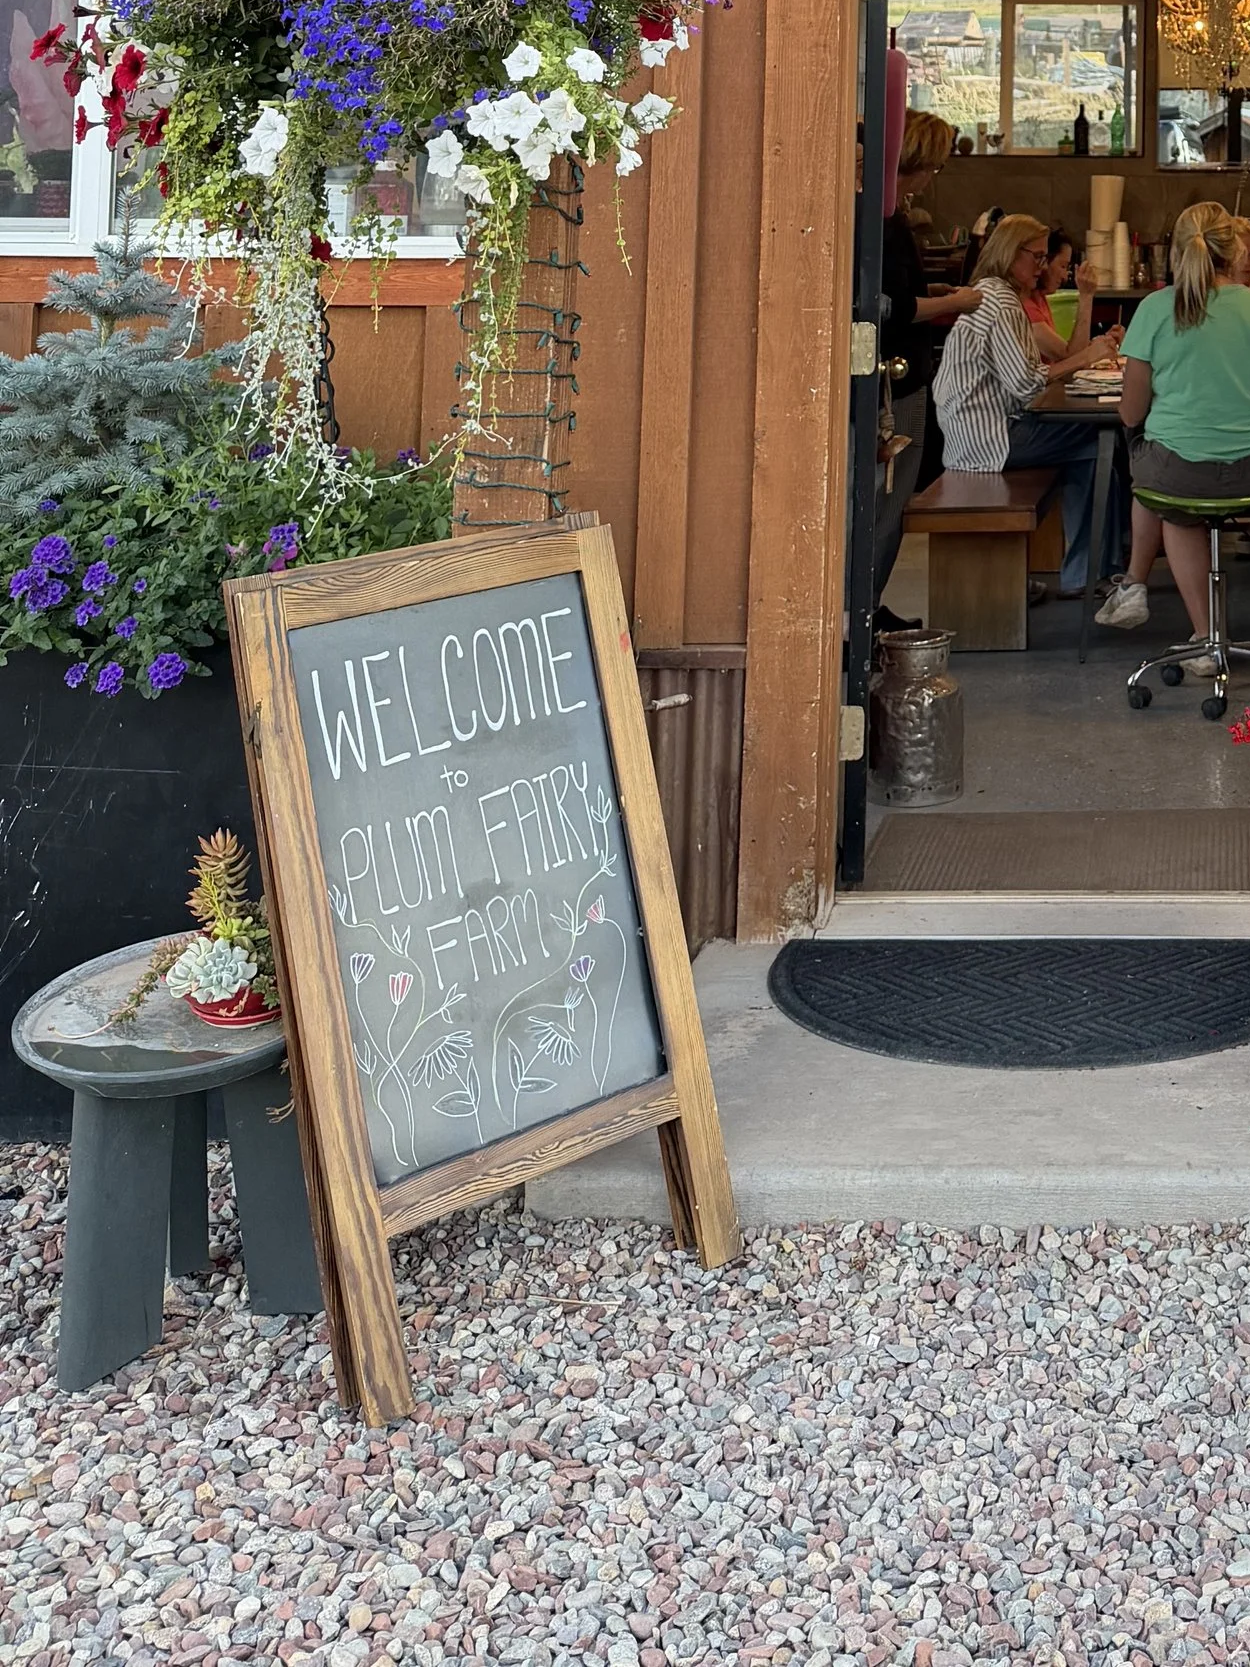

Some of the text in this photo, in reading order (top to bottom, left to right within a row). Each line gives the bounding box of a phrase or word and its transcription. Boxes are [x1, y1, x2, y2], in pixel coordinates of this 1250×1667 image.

[310, 606, 588, 781] WELCOME
[339, 761, 605, 924] PLUM FAIRY
[440, 764, 469, 794] to
[425, 887, 550, 990] FARM
